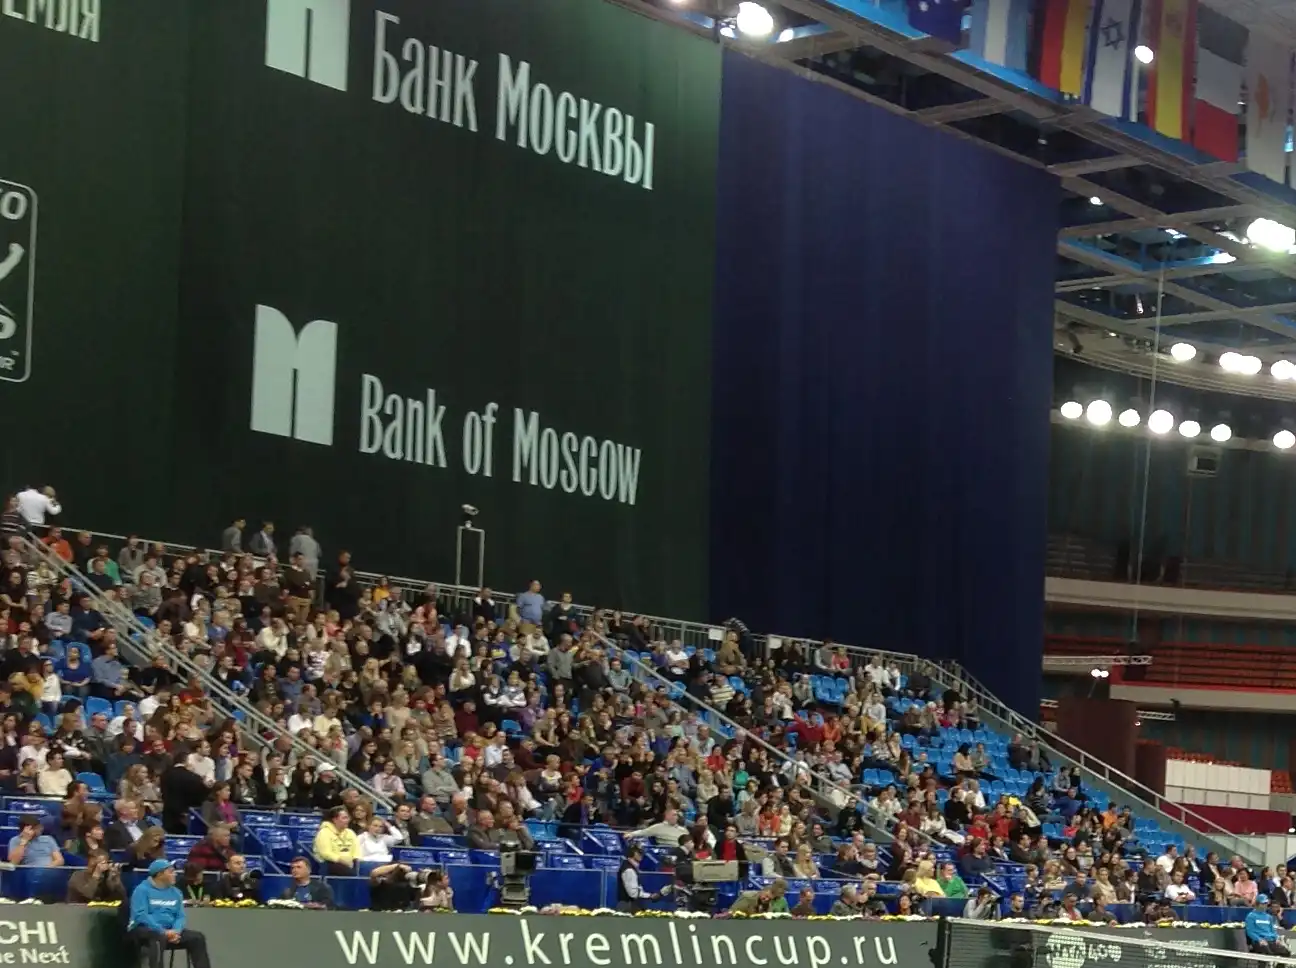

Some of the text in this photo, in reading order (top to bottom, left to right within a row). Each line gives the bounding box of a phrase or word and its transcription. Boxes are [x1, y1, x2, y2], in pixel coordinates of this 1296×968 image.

[372, 9, 655, 190] Банк Москвы
[359, 373, 641, 505] Bank of Moscow
[18, 945, 70, 964] Next
